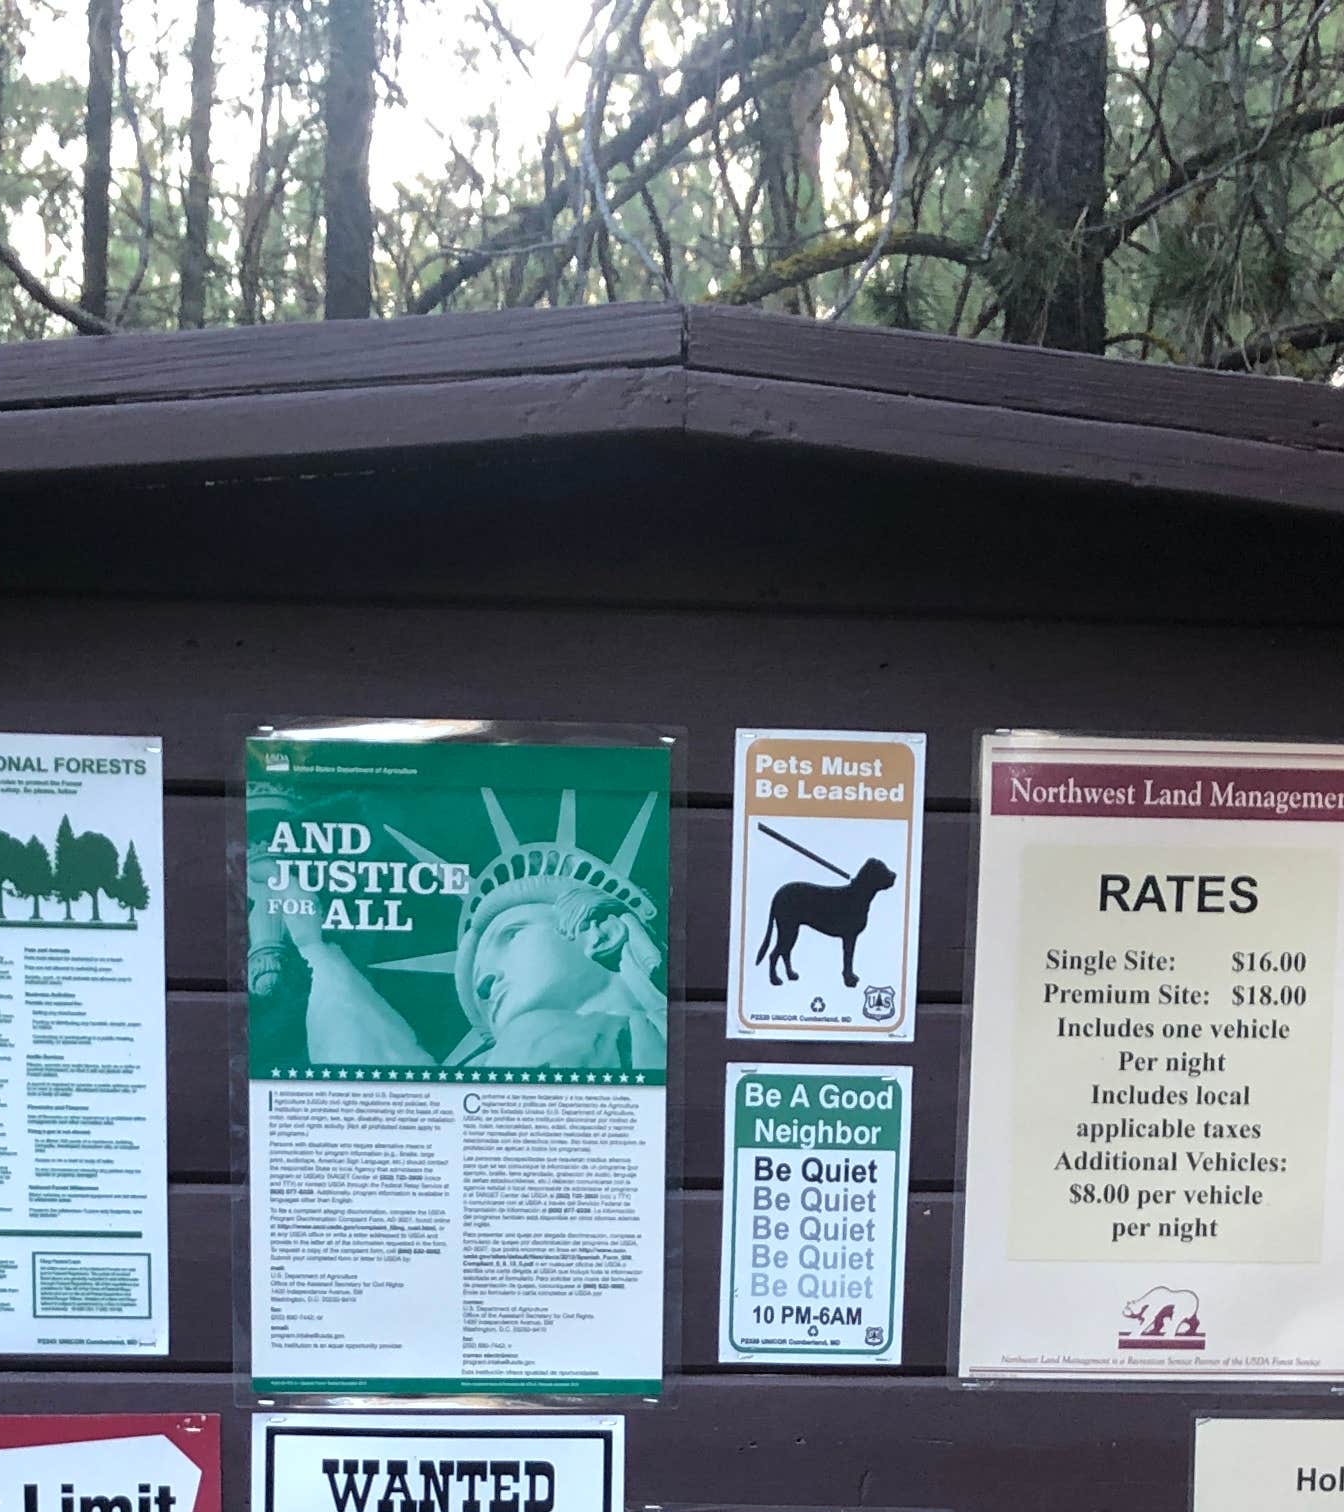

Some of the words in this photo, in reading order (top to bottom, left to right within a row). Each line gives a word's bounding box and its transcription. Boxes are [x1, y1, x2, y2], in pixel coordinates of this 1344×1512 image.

[53, 757, 147, 776] FORESTS
[755, 753, 813, 775] Pets
[821, 756, 883, 778] Must
[755, 778, 789, 799] Be
[797, 779, 905, 803] Leashed
[1009, 774, 1136, 805] Northwest
[1143, 779, 1202, 807] Land
[267, 821, 371, 855] AND
[266, 859, 471, 895] JUSTICE
[1099, 874, 1258, 914] RATES
[268, 897, 317, 916] FOR
[320, 898, 413, 932] ALL
[1046, 949, 1117, 976] Single
[1124, 950, 1175, 972] Site:
[1231, 951, 1307, 973] $16.00
[745, 1082, 782, 1108] Be
[789, 1083, 811, 1108] A
[818, 1083, 893, 1110] Good
[754, 1118, 882, 1148] Neighbor
[754, 1155, 792, 1182] Be
[801, 1157, 878, 1185] Quiet
[752, 1305, 775, 1325] 10
[781, 1305, 862, 1326] PM-6AM
